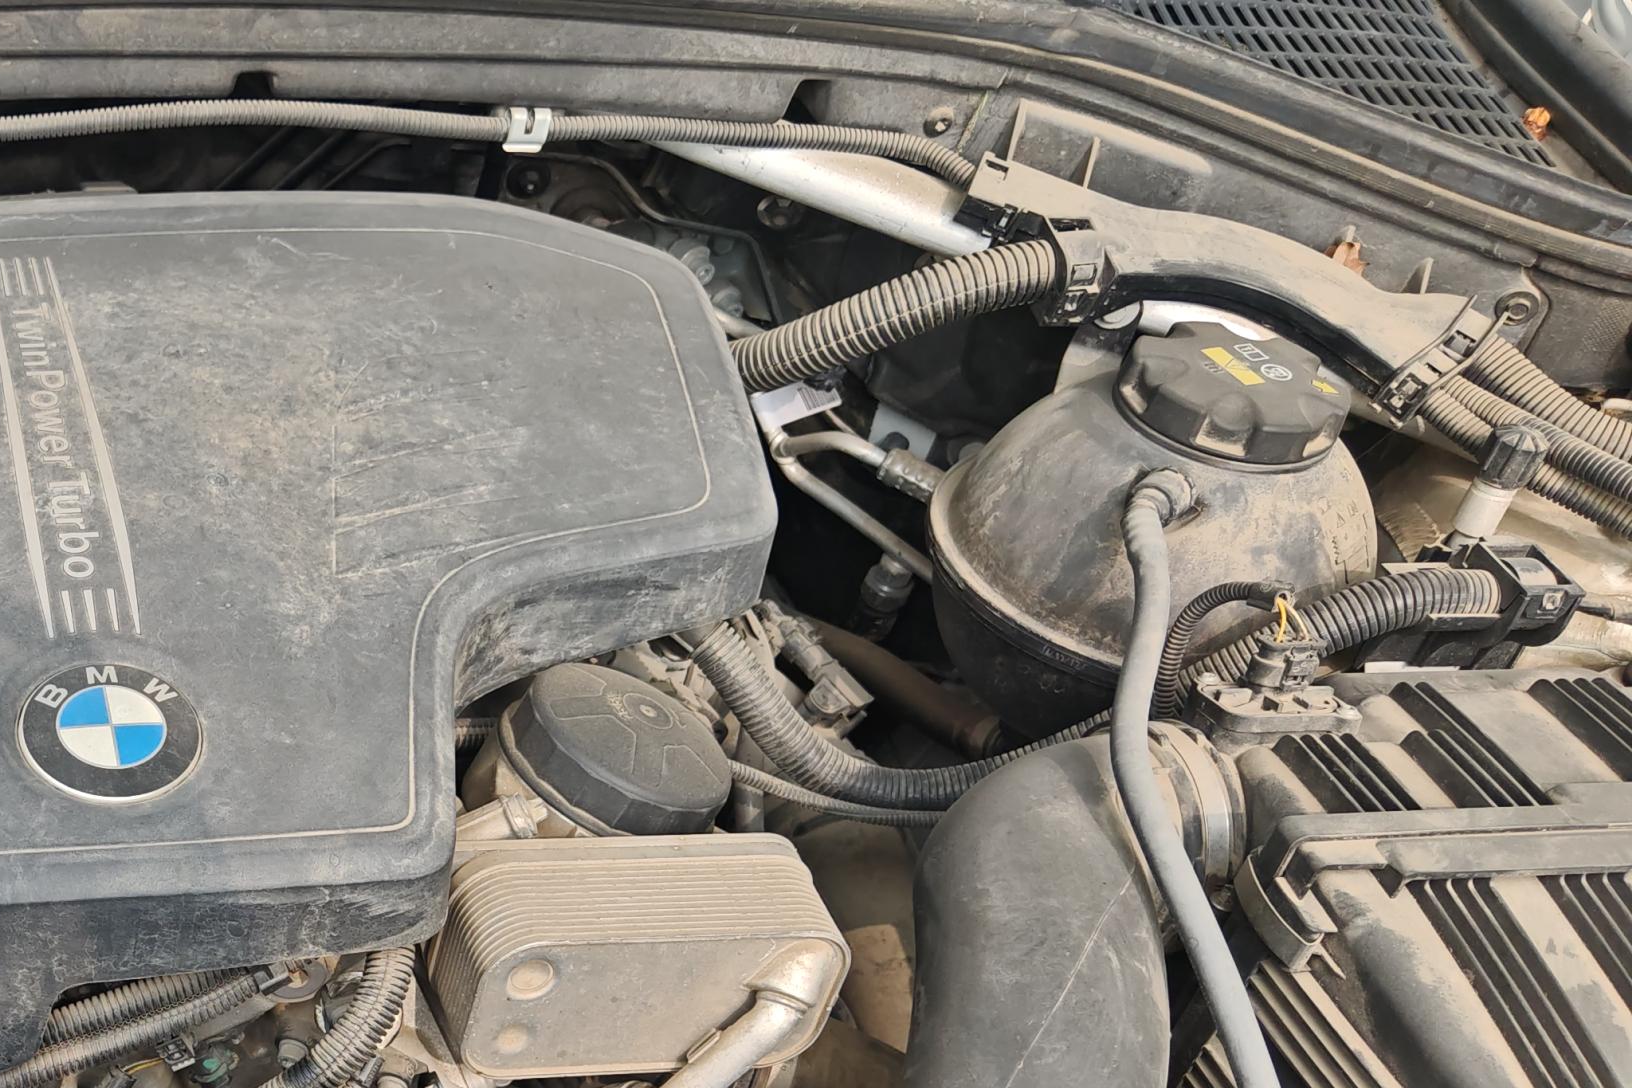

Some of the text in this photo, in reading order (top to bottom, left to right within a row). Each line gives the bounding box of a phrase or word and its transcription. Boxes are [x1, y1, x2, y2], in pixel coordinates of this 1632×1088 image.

[9, 303, 99, 579] TwinPower Turbo
[33, 663, 178, 710] BMW
